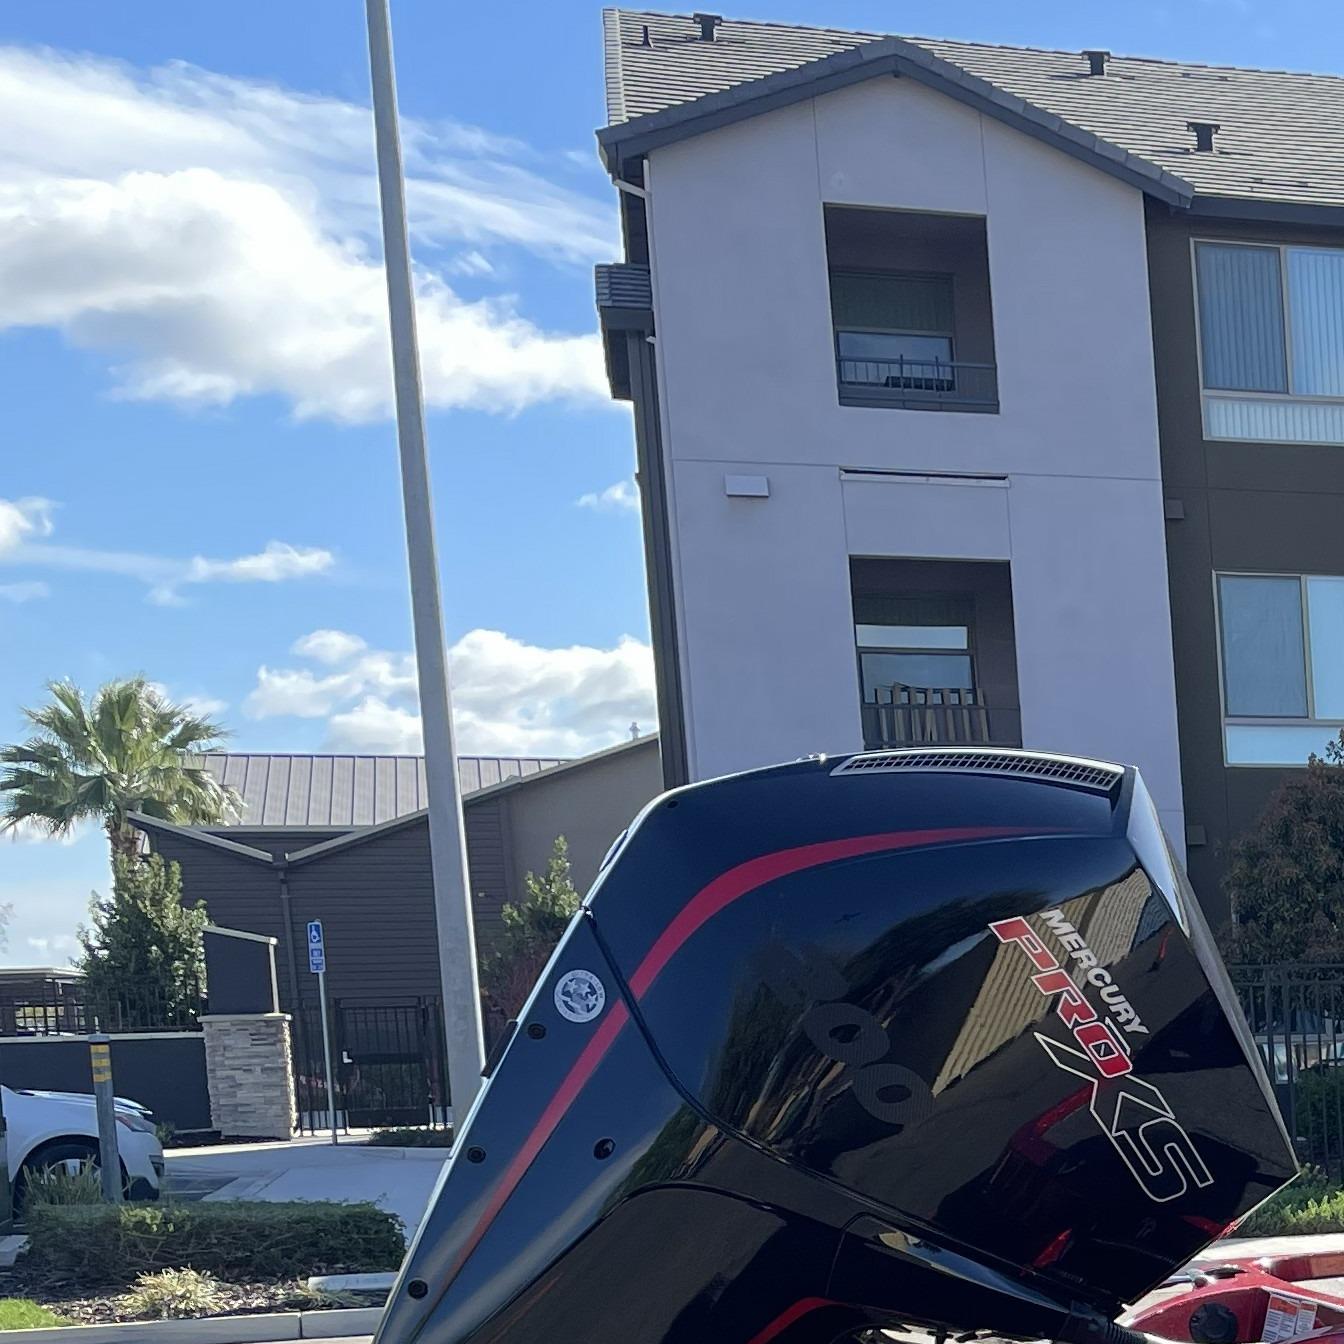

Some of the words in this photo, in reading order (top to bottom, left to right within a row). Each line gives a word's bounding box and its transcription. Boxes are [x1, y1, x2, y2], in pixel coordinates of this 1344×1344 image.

[988, 916, 1133, 1078] PRO
[1039, 908, 1150, 1034] MERCURY
[1033, 1016, 1215, 1203] XS
